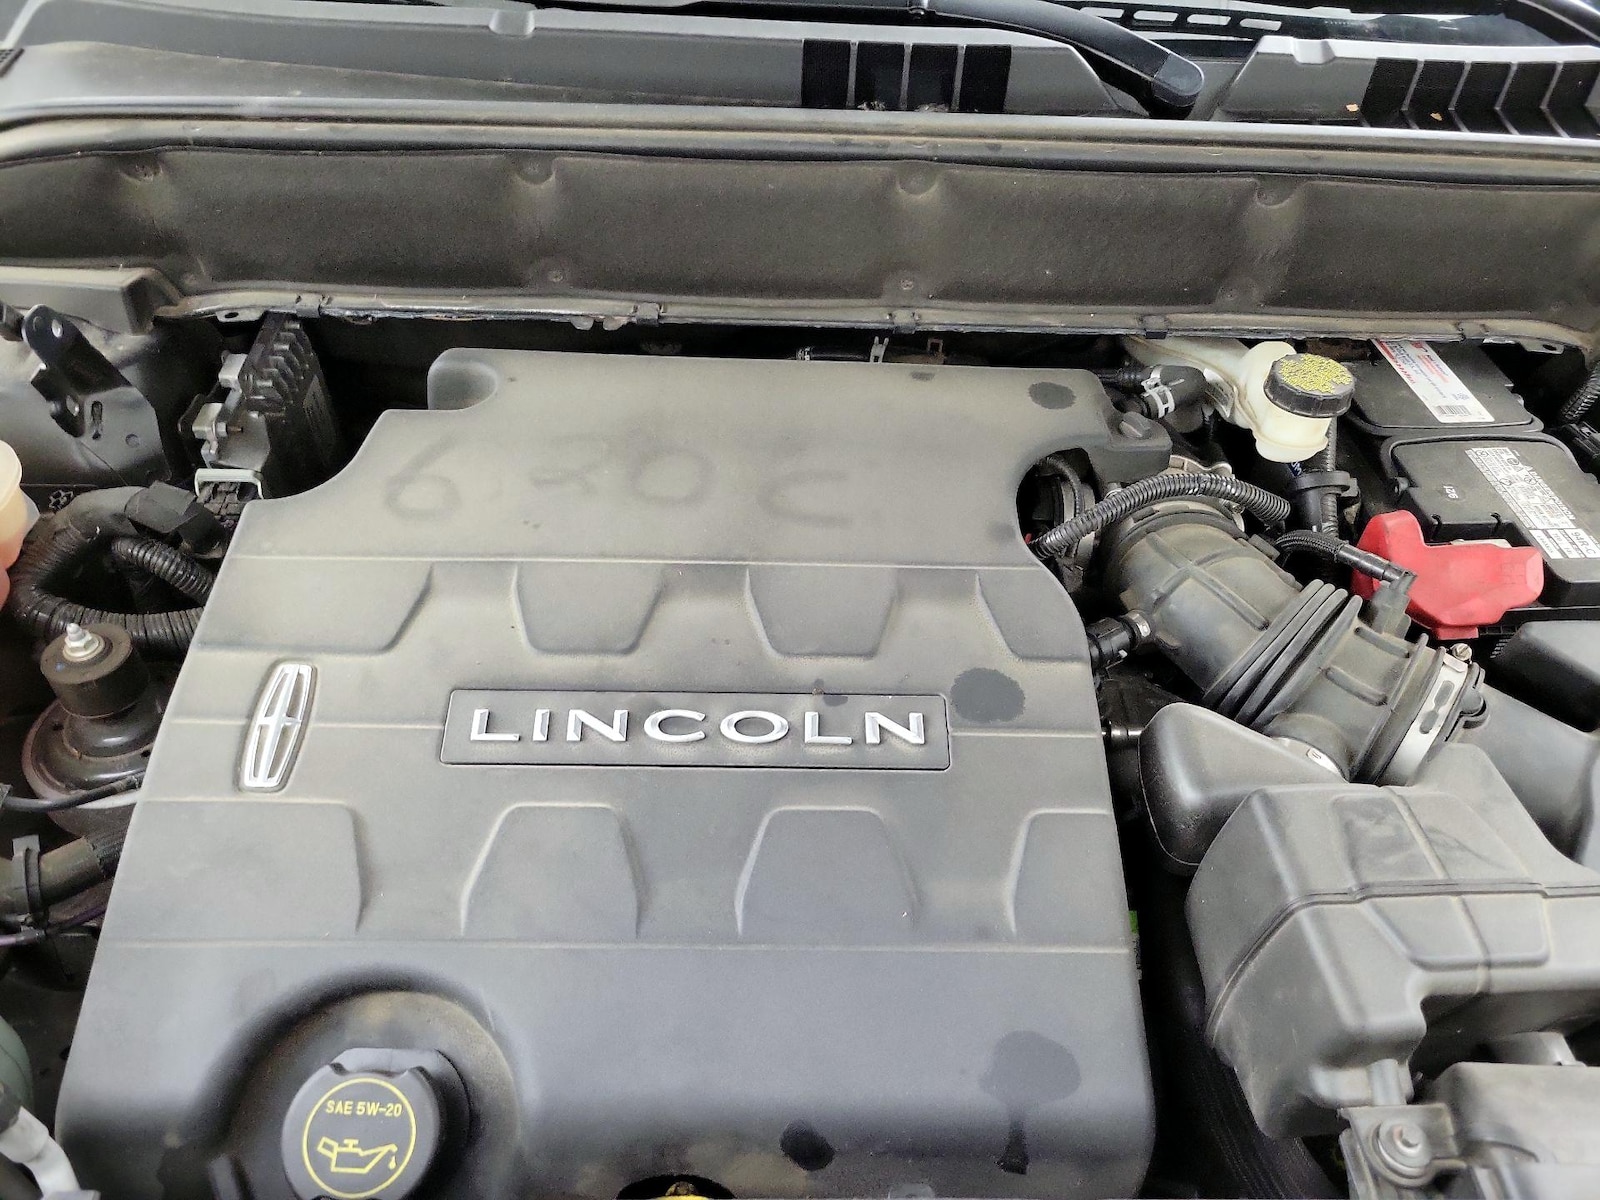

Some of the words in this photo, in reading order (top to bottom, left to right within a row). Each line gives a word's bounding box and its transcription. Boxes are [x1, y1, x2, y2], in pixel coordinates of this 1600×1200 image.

[470, 708, 926, 746] LINCOLN
[325, 1099, 354, 1115] SAE
[356, 1101, 403, 1118] 5W-20
